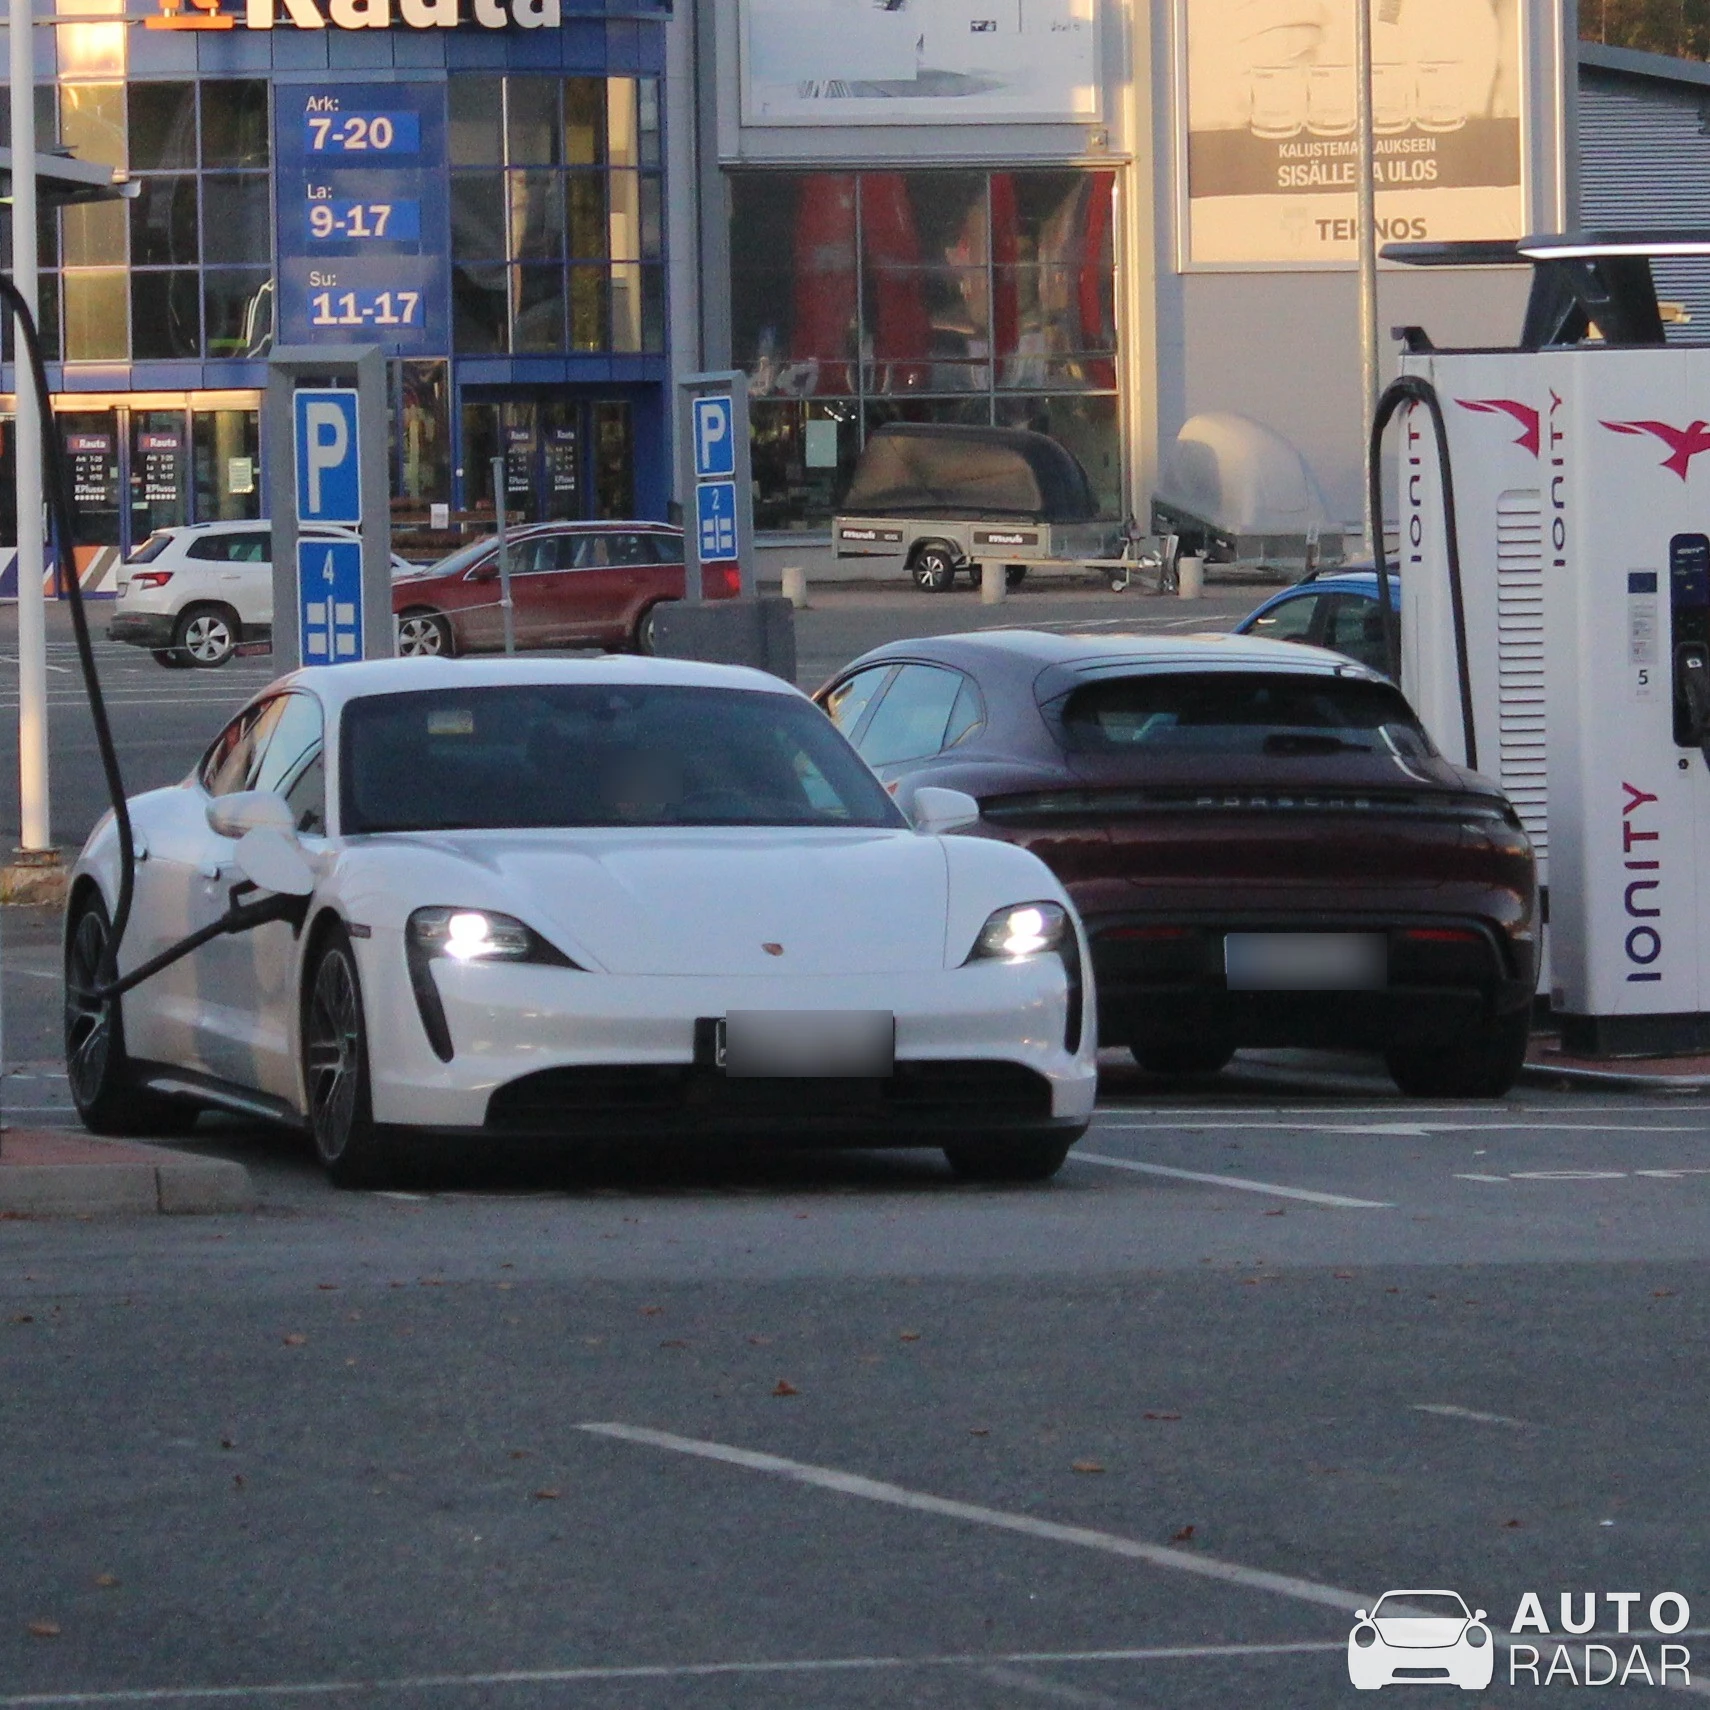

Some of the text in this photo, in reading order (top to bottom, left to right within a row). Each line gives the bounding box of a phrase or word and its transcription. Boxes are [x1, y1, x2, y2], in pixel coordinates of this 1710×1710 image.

[306, 96, 339, 111] Ark:
[309, 117, 393, 149] 7-20
[1279, 138, 1436, 158] KALUSTEMAAUKSEEN
[1278, 159, 1355, 187] SISÄLLE
[1388, 159, 1437, 182] ULOS
[307, 184, 332, 199] La:
[310, 205, 391, 237] 9-17
[1315, 218, 1427, 241] TENOS
[309, 271, 336, 286] Su:
[313, 292, 418, 325] 11-17
[701, 404, 726, 469] P
[306, 402, 348, 513] P
[1549, 387, 1566, 567] IONITY
[712, 488, 720, 510] 2
[322, 549, 334, 585] 4
[1638, 669, 1648, 685] 5
[1622, 781, 1661, 982] IONITY
